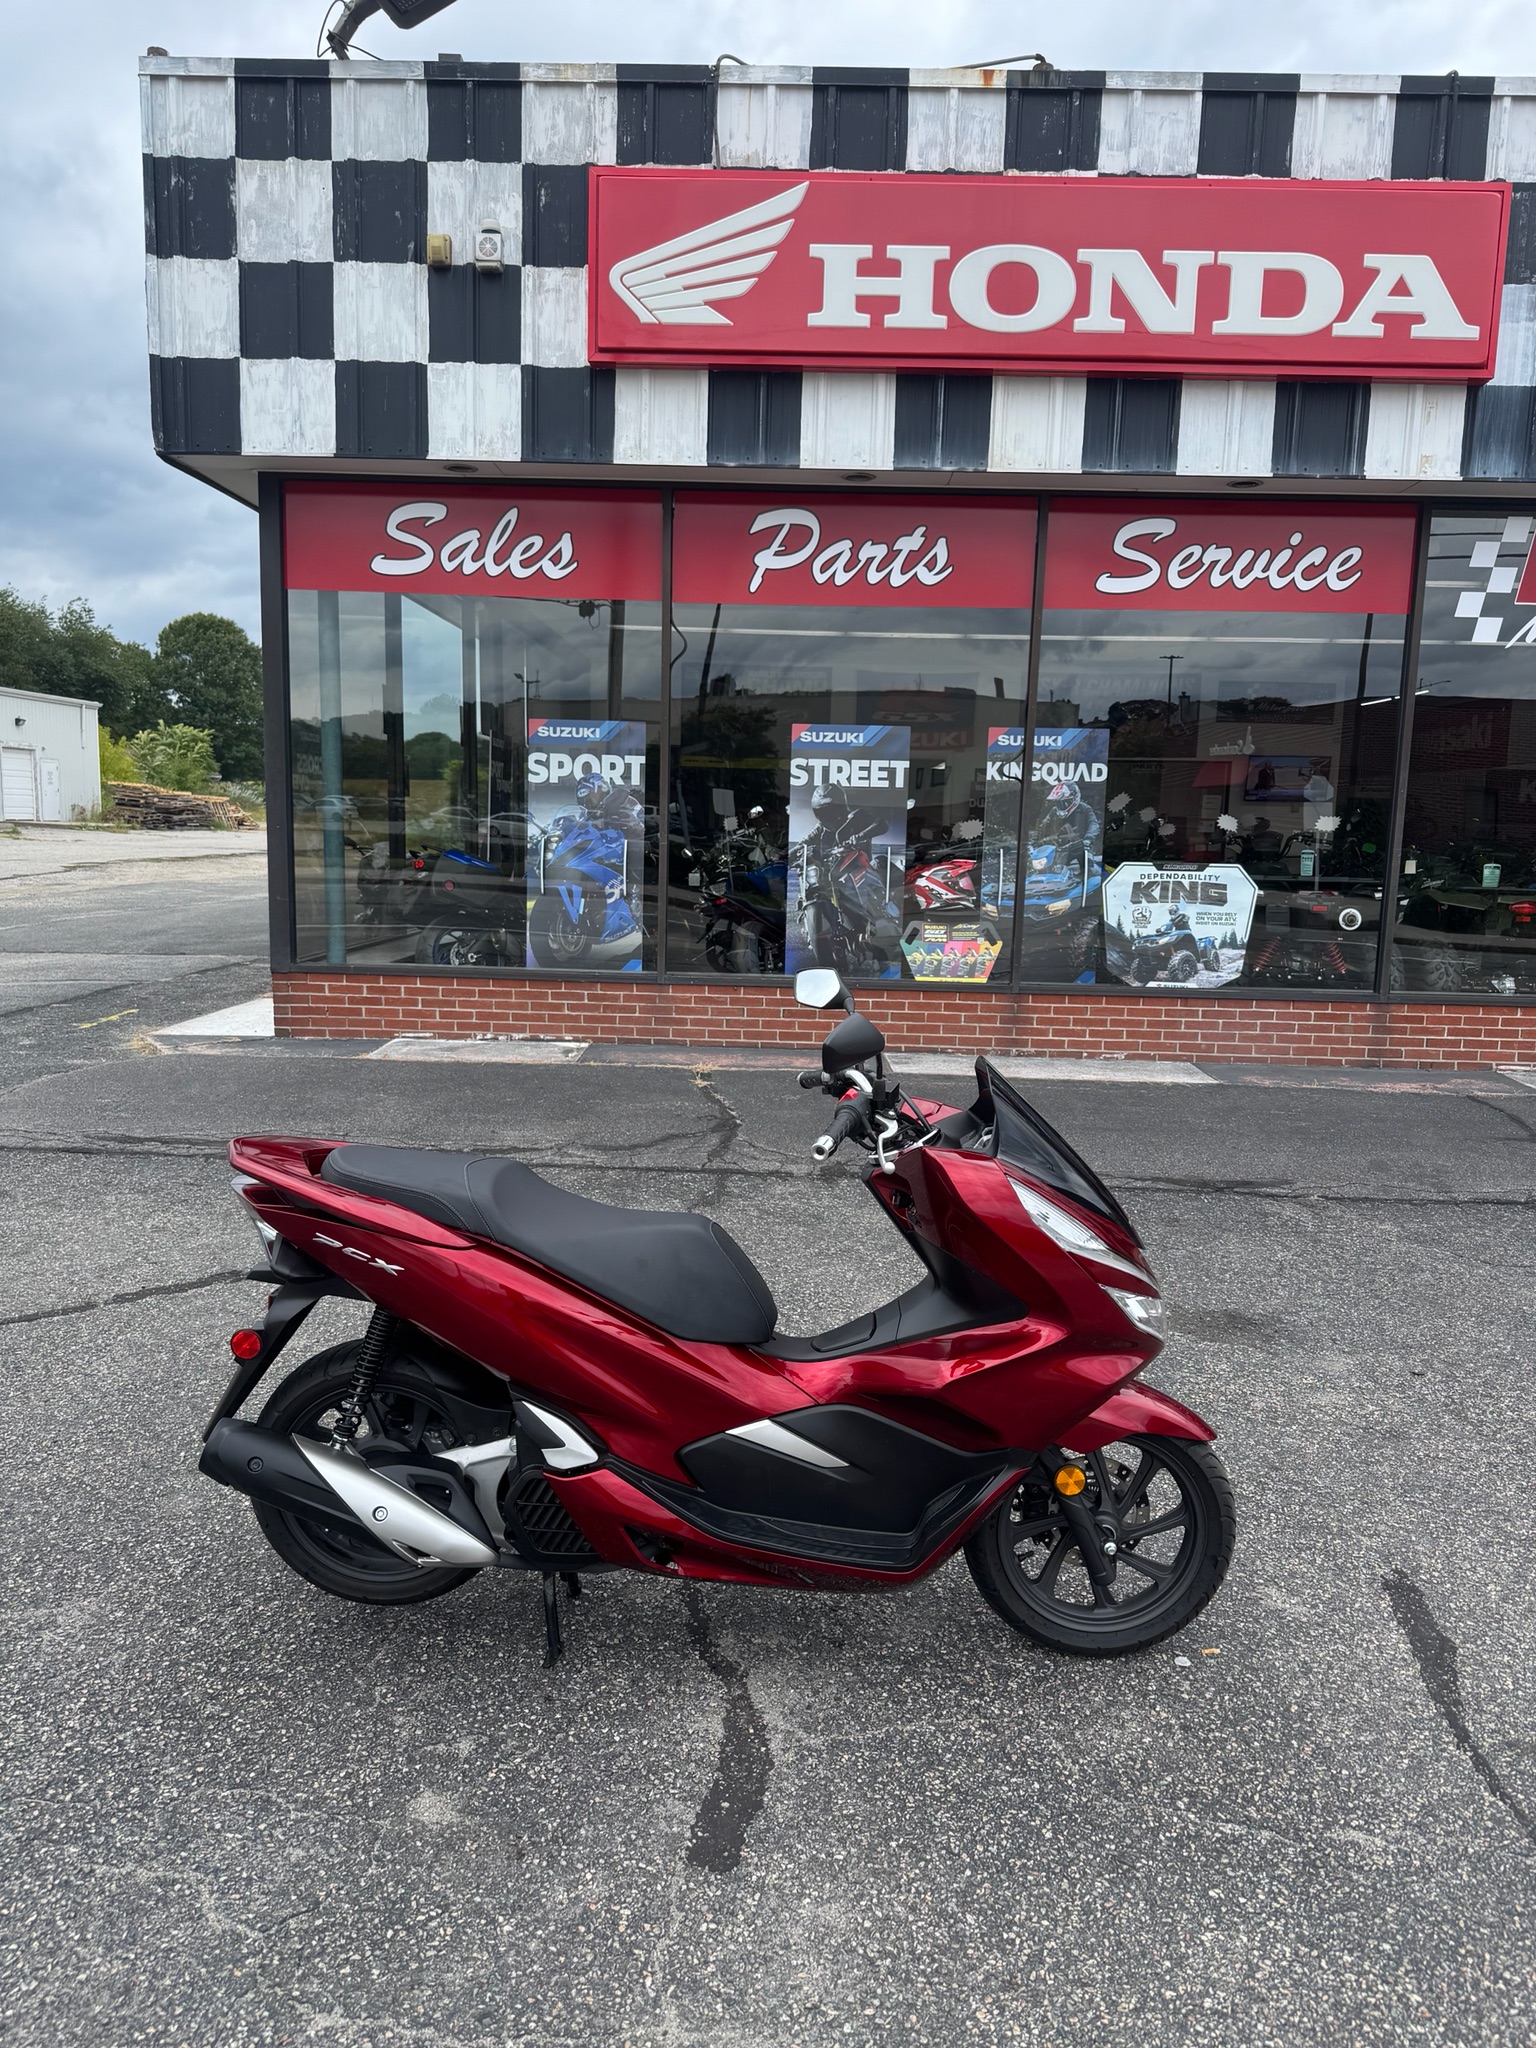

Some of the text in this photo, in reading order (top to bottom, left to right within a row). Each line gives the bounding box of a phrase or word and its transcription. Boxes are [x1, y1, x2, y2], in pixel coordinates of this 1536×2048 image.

[807, 243, 1480, 340] HONDA
[370, 501, 578, 580] Sales
[748, 507, 955, 594] Parts
[1095, 517, 1363, 594] Service
[537, 725, 600, 739] SUZUKI
[800, 730, 865, 744] SUZUKI
[911, 731, 967, 747] ZUKI
[997, 734, 1062, 747] SUUKI
[528, 752, 646, 786] SPORT
[790, 757, 910, 789] STREET
[1139, 873, 1221, 882] DEPENDABILITY
[1130, 881, 1228, 907] KING
[312, 1232, 405, 1276] PCX
